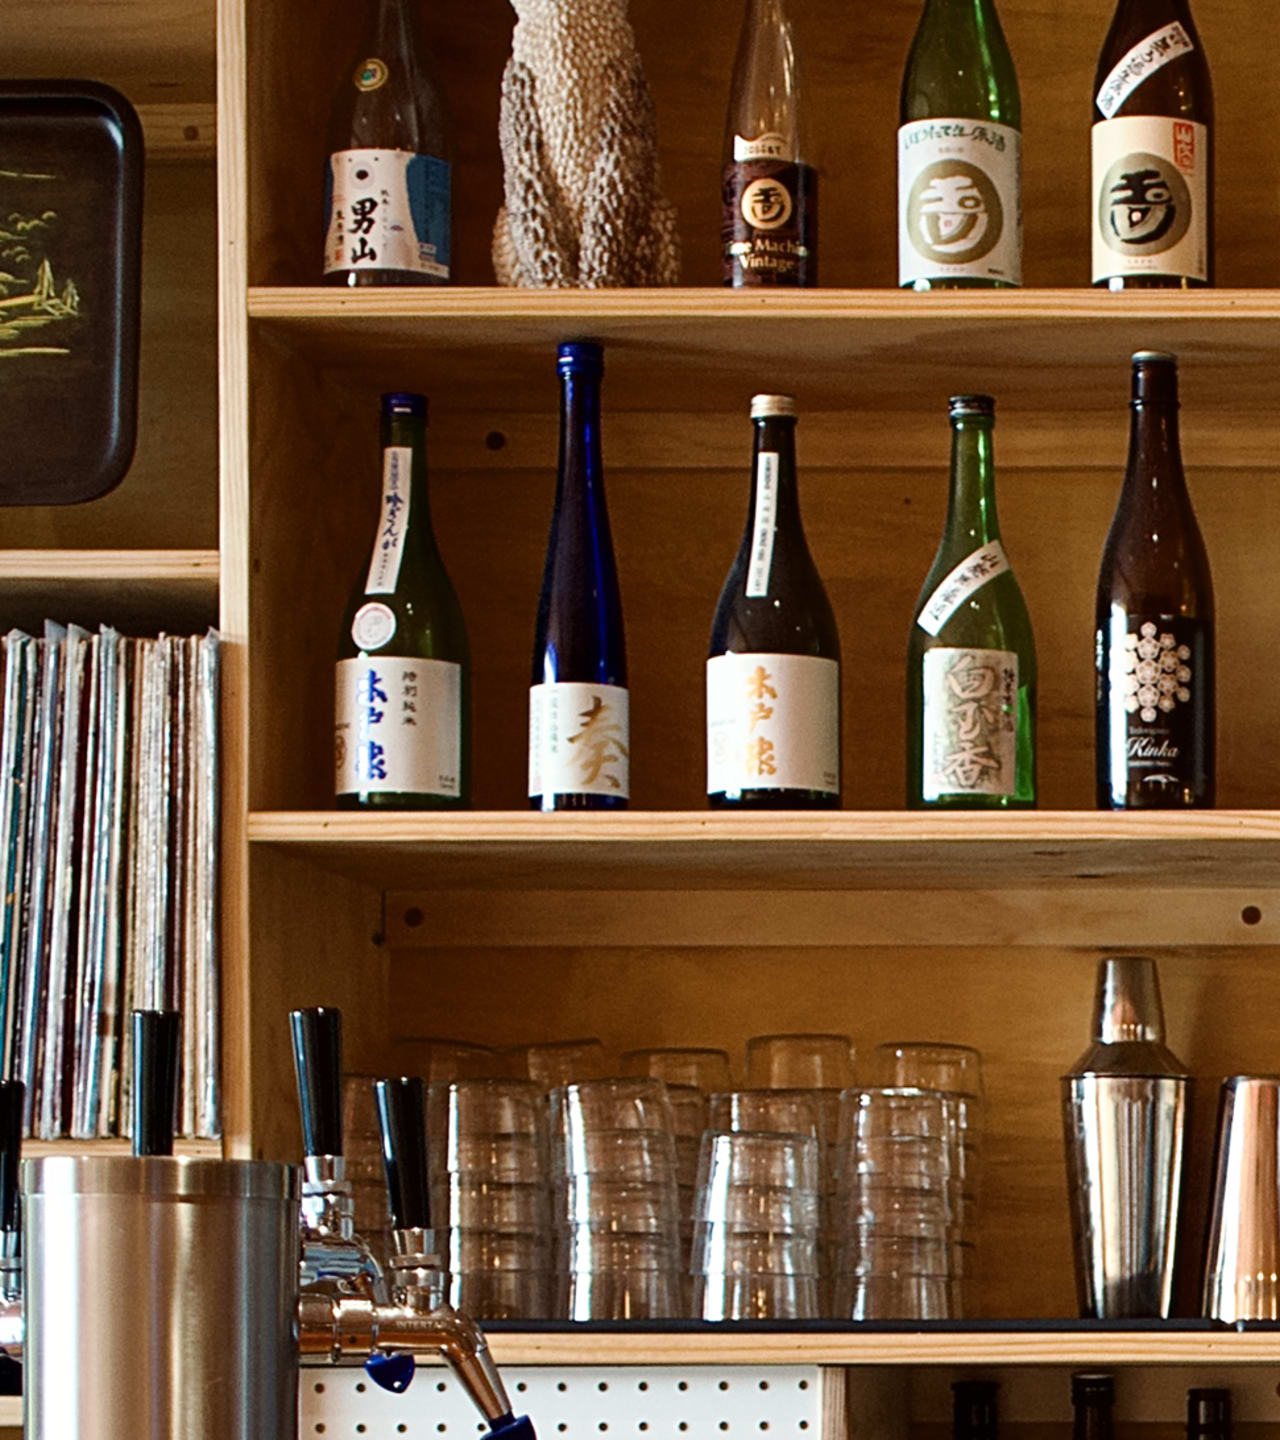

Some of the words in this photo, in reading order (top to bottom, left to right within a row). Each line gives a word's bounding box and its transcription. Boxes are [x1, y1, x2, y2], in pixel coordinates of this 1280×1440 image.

[347, 197, 379, 263] 男山
[740, 254, 794, 272] Vintage
[1128, 736, 1179, 758] Kinka
